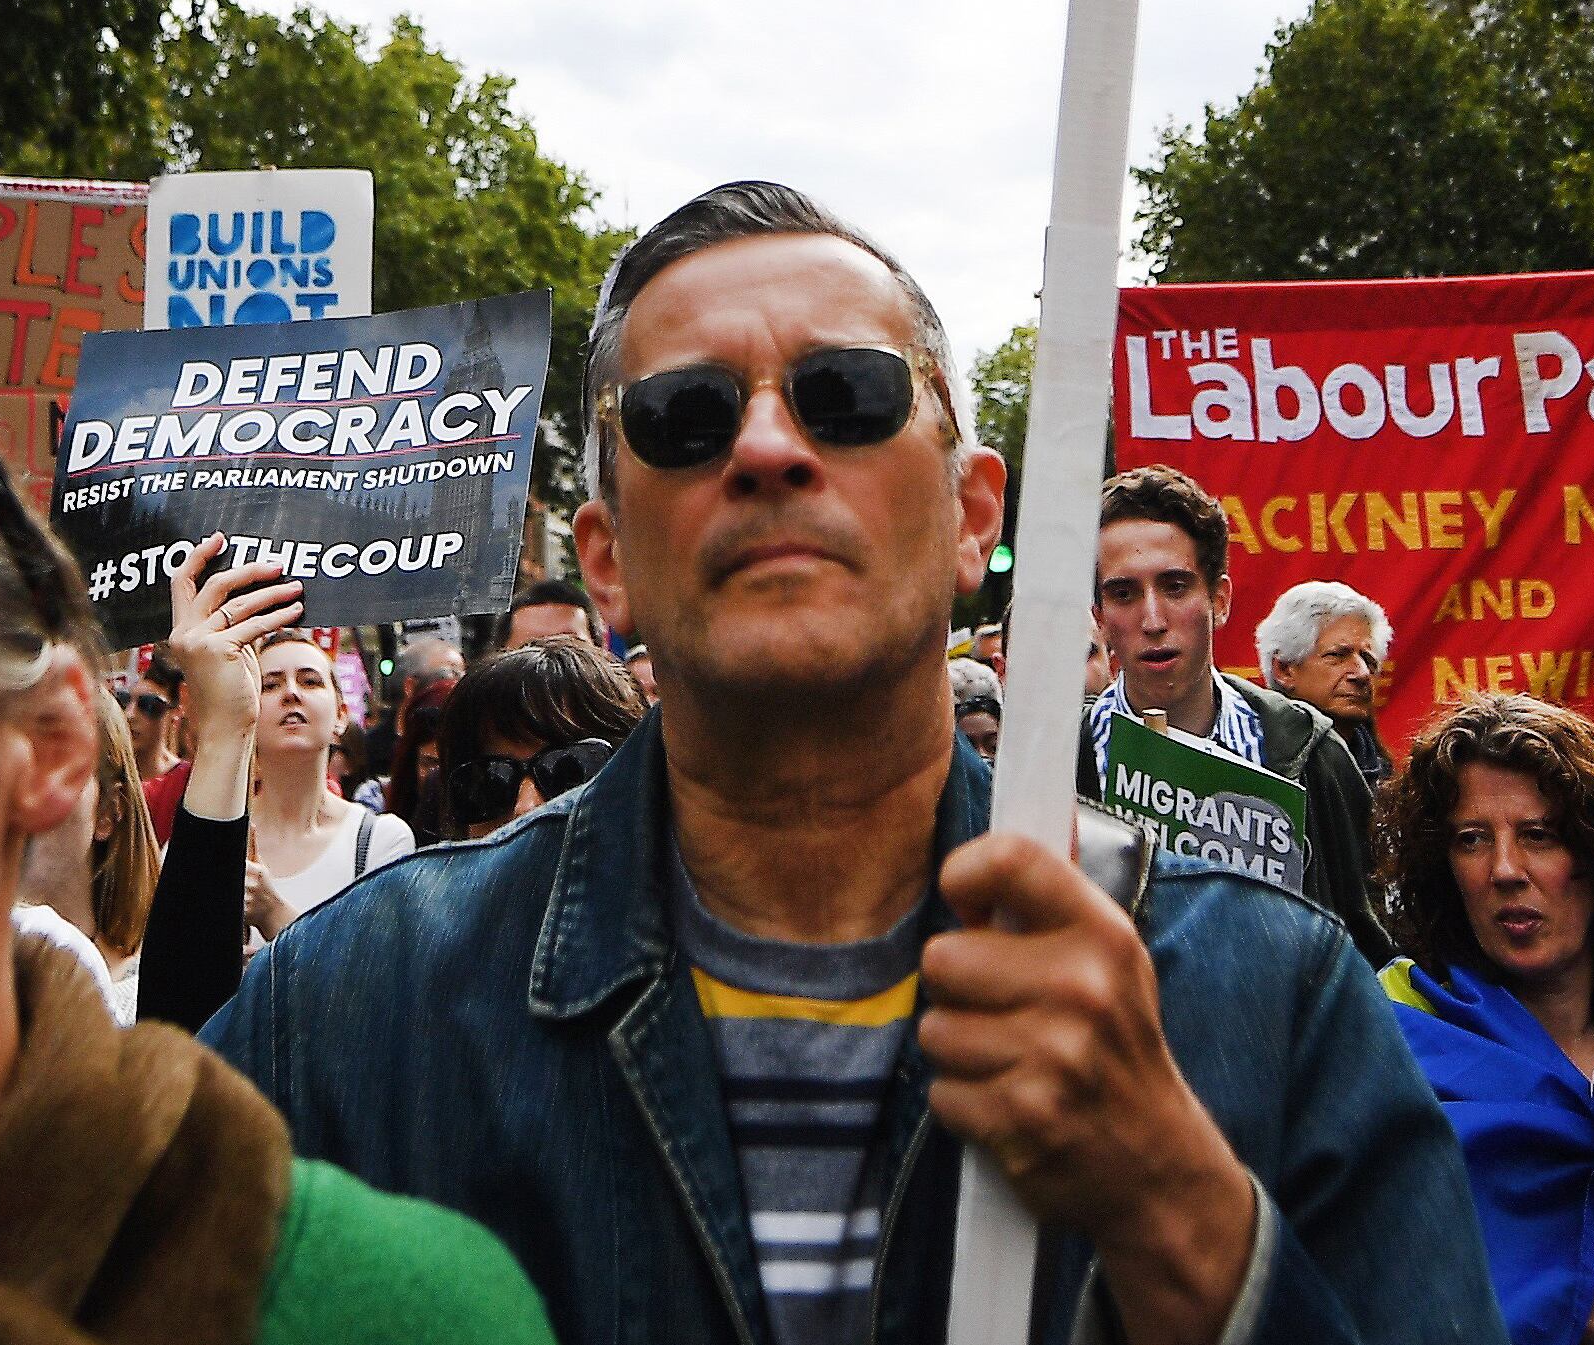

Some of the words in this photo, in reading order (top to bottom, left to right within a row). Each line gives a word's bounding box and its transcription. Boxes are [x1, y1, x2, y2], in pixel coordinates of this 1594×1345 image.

[169, 210, 336, 256] BUILD
[168, 257, 334, 292] UNIONS
[171, 342, 443, 409] DEFEND
[1153, 327, 1239, 362] THE
[1126, 336, 1499, 443] Labour
[66, 385, 535, 475] DEMOCRACY
[62, 477, 133, 513] RESIST
[140, 470, 186, 494] THE
[191, 467, 358, 493] PARLIAMENT
[363, 451, 516, 491] SHUTDOWN
[1221, 489, 1517, 555] ACKNEY
[1433, 578, 1556, 623] AND
[1115, 762, 1291, 854] MIGRANTS
